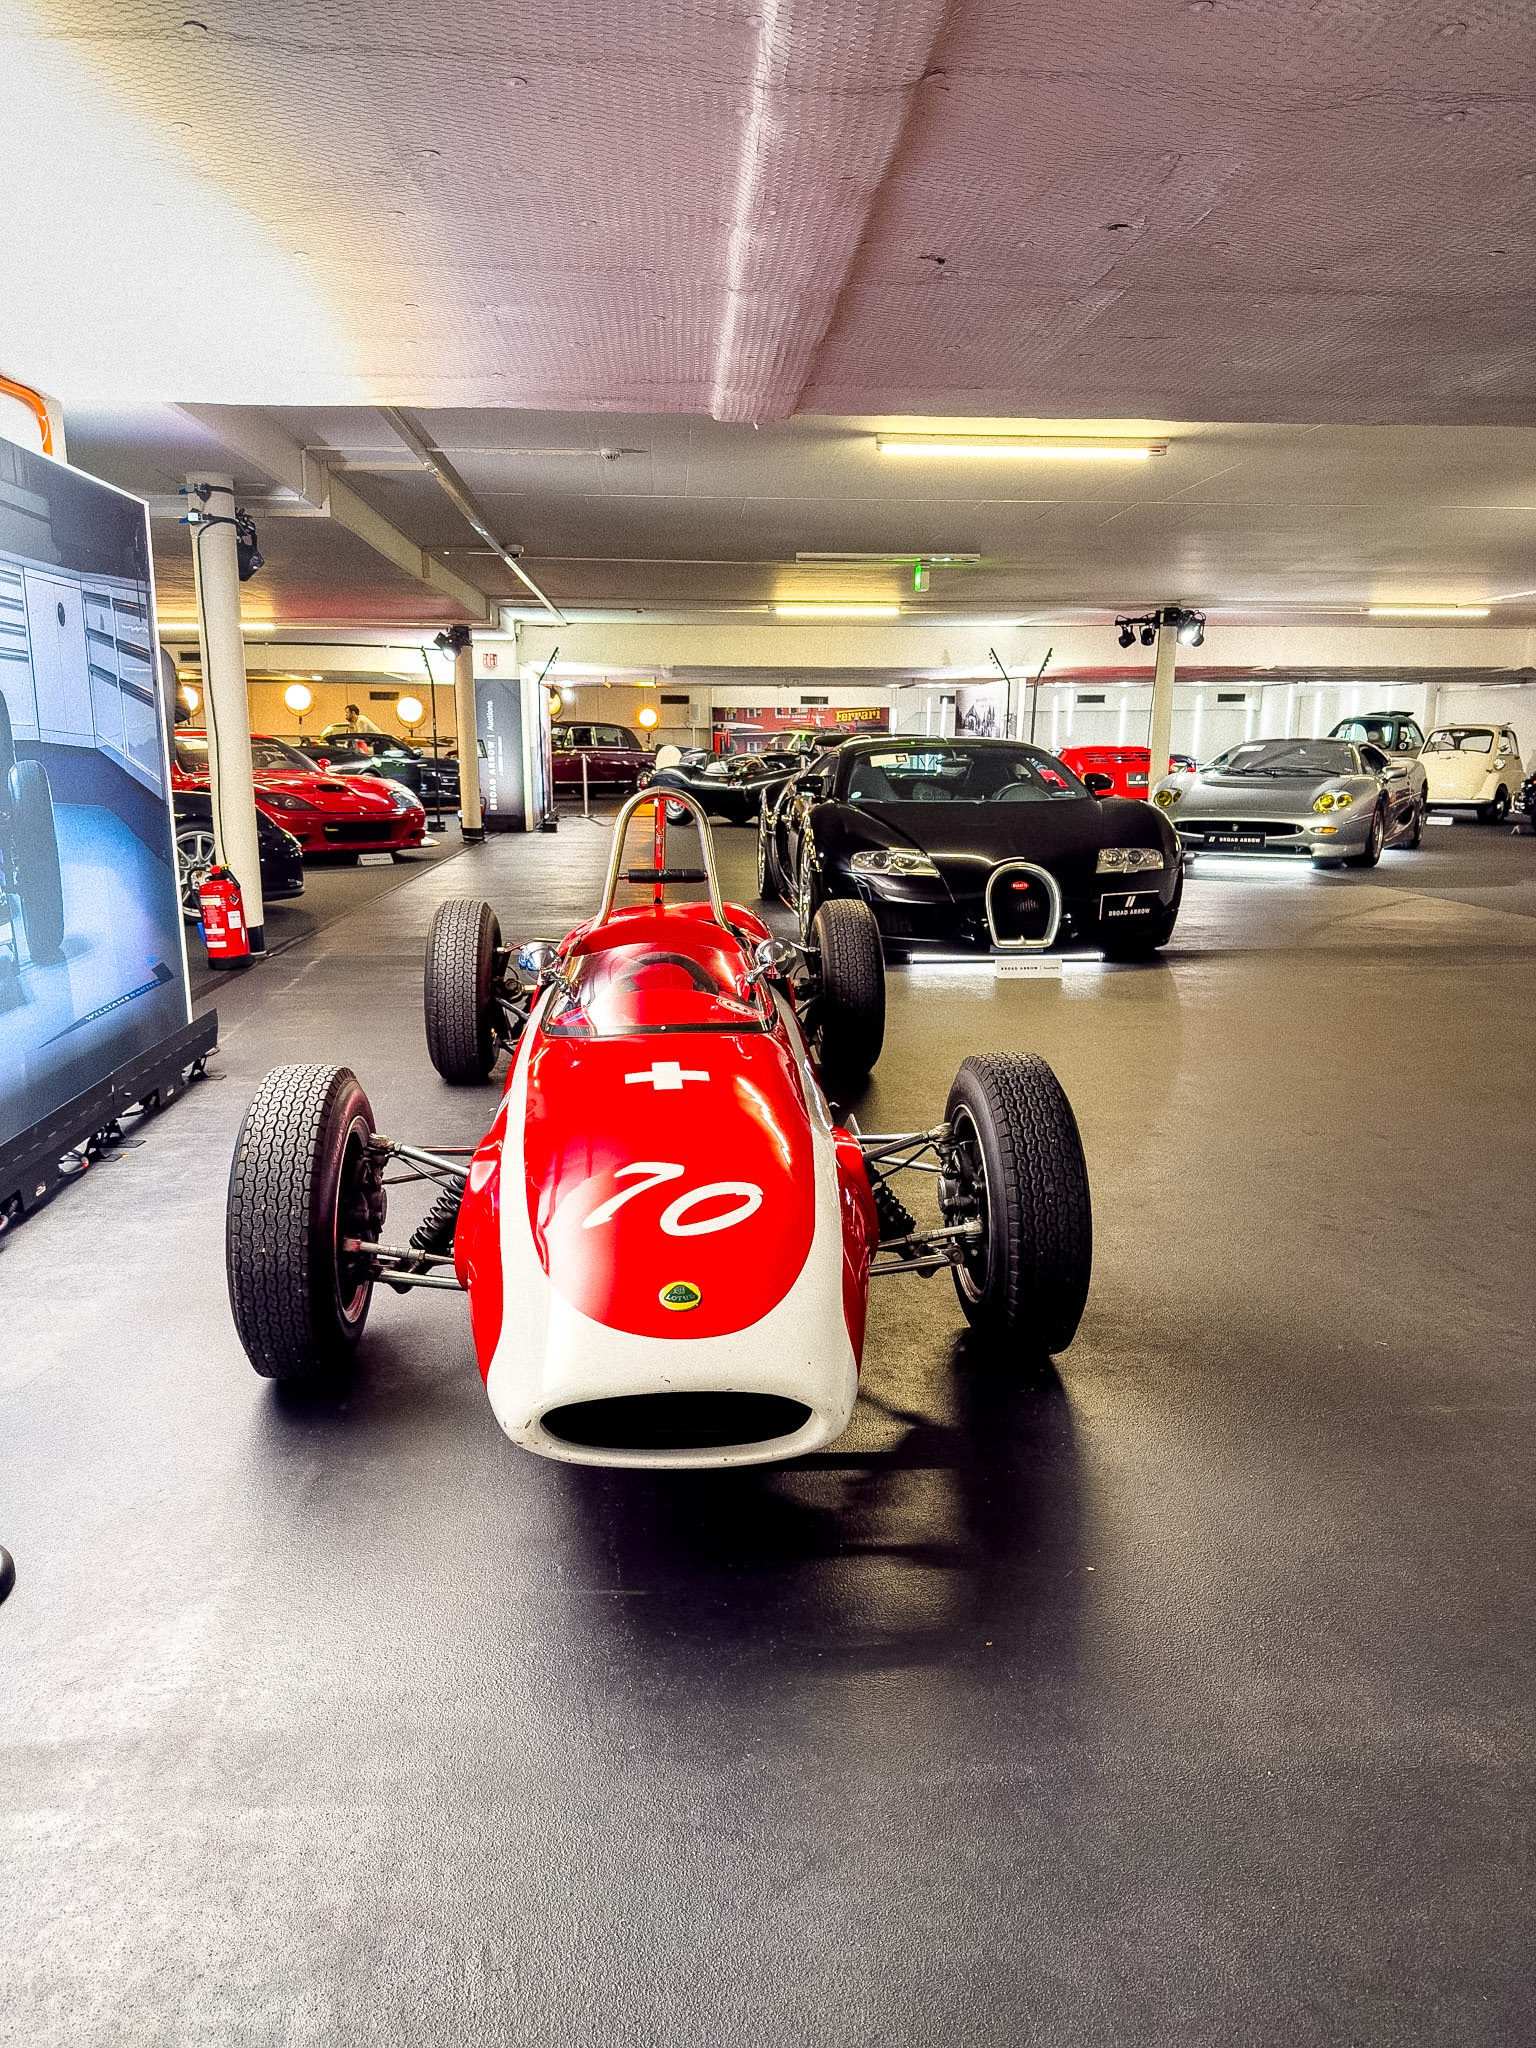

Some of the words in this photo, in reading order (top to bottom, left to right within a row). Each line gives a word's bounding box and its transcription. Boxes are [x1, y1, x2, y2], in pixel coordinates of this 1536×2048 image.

[486, 699, 494, 732] Auctions
[835, 708, 881, 722] Ferrari
[487, 741, 496, 776] ARROW
[489, 778, 498, 811] BROAD
[1108, 909, 1129, 917] BROAD
[85, 995, 130, 1021] WILLIAMS
[582, 1161, 764, 1237] 70
[665, 1294, 696, 1302] LOTUS
